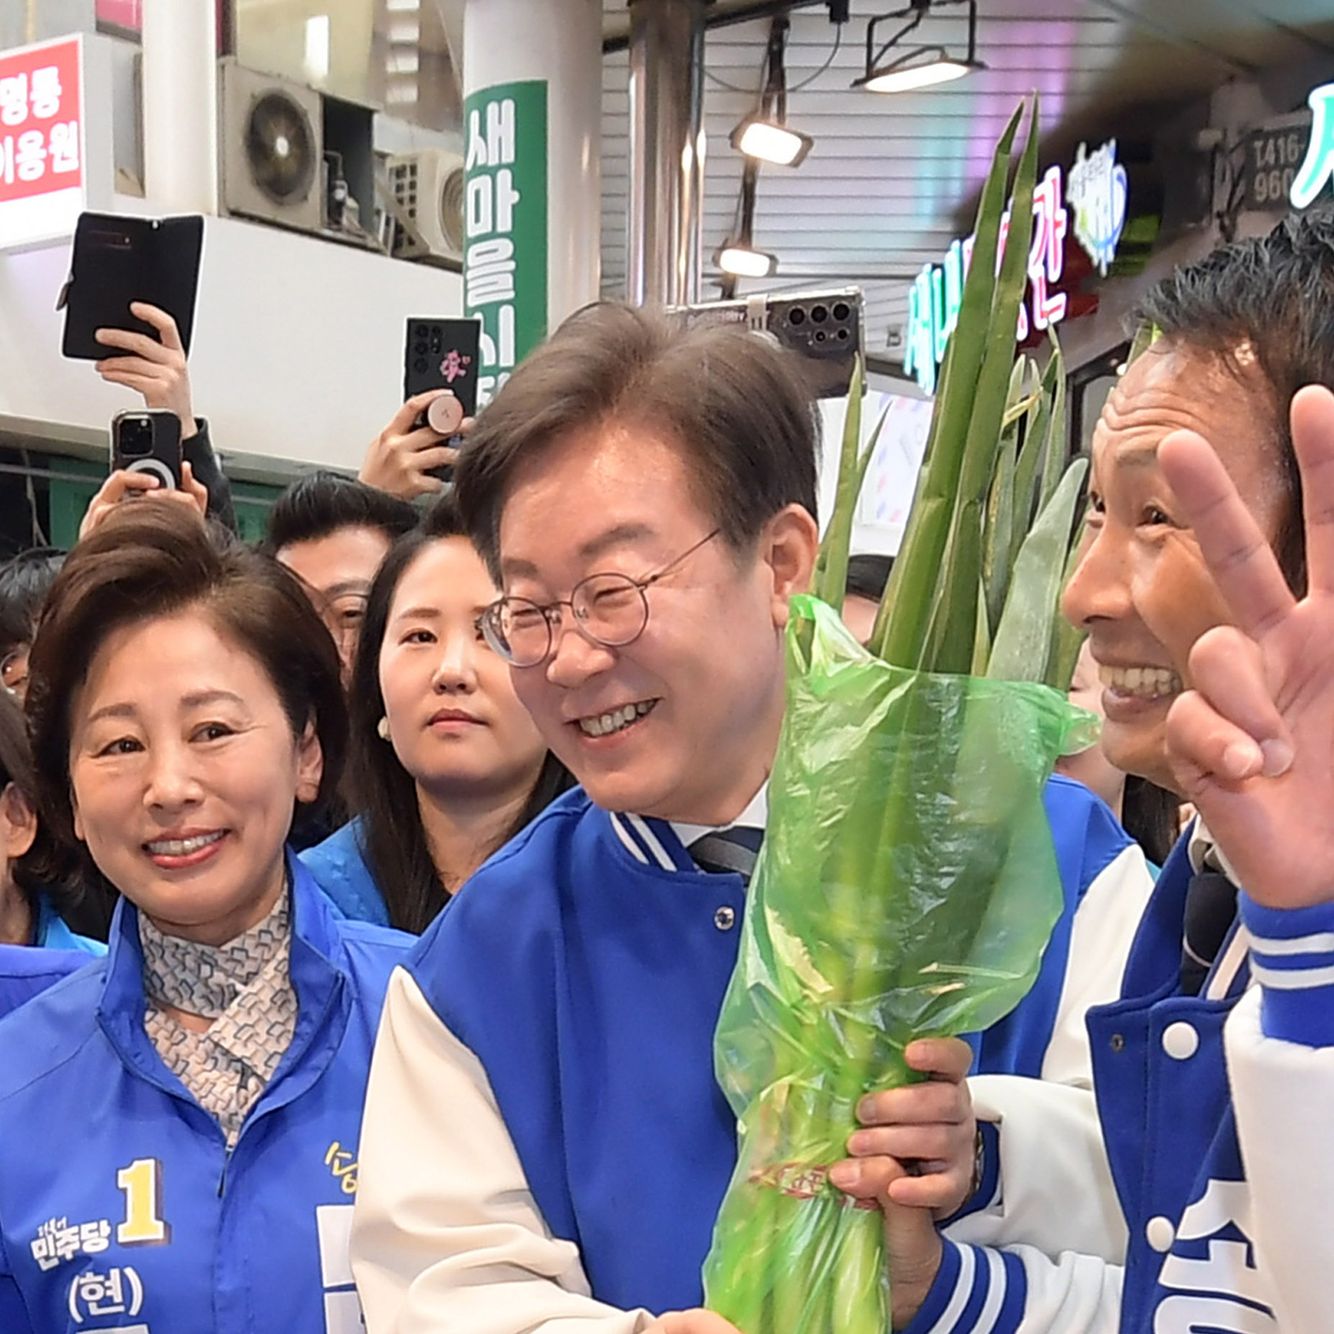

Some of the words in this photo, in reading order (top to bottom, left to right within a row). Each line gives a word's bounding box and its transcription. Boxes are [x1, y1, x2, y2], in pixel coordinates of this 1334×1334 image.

[466, 98, 520, 408] 새마을시
[117, 1158, 165, 1244] 1
[30, 1219, 112, 1272] 민주당
